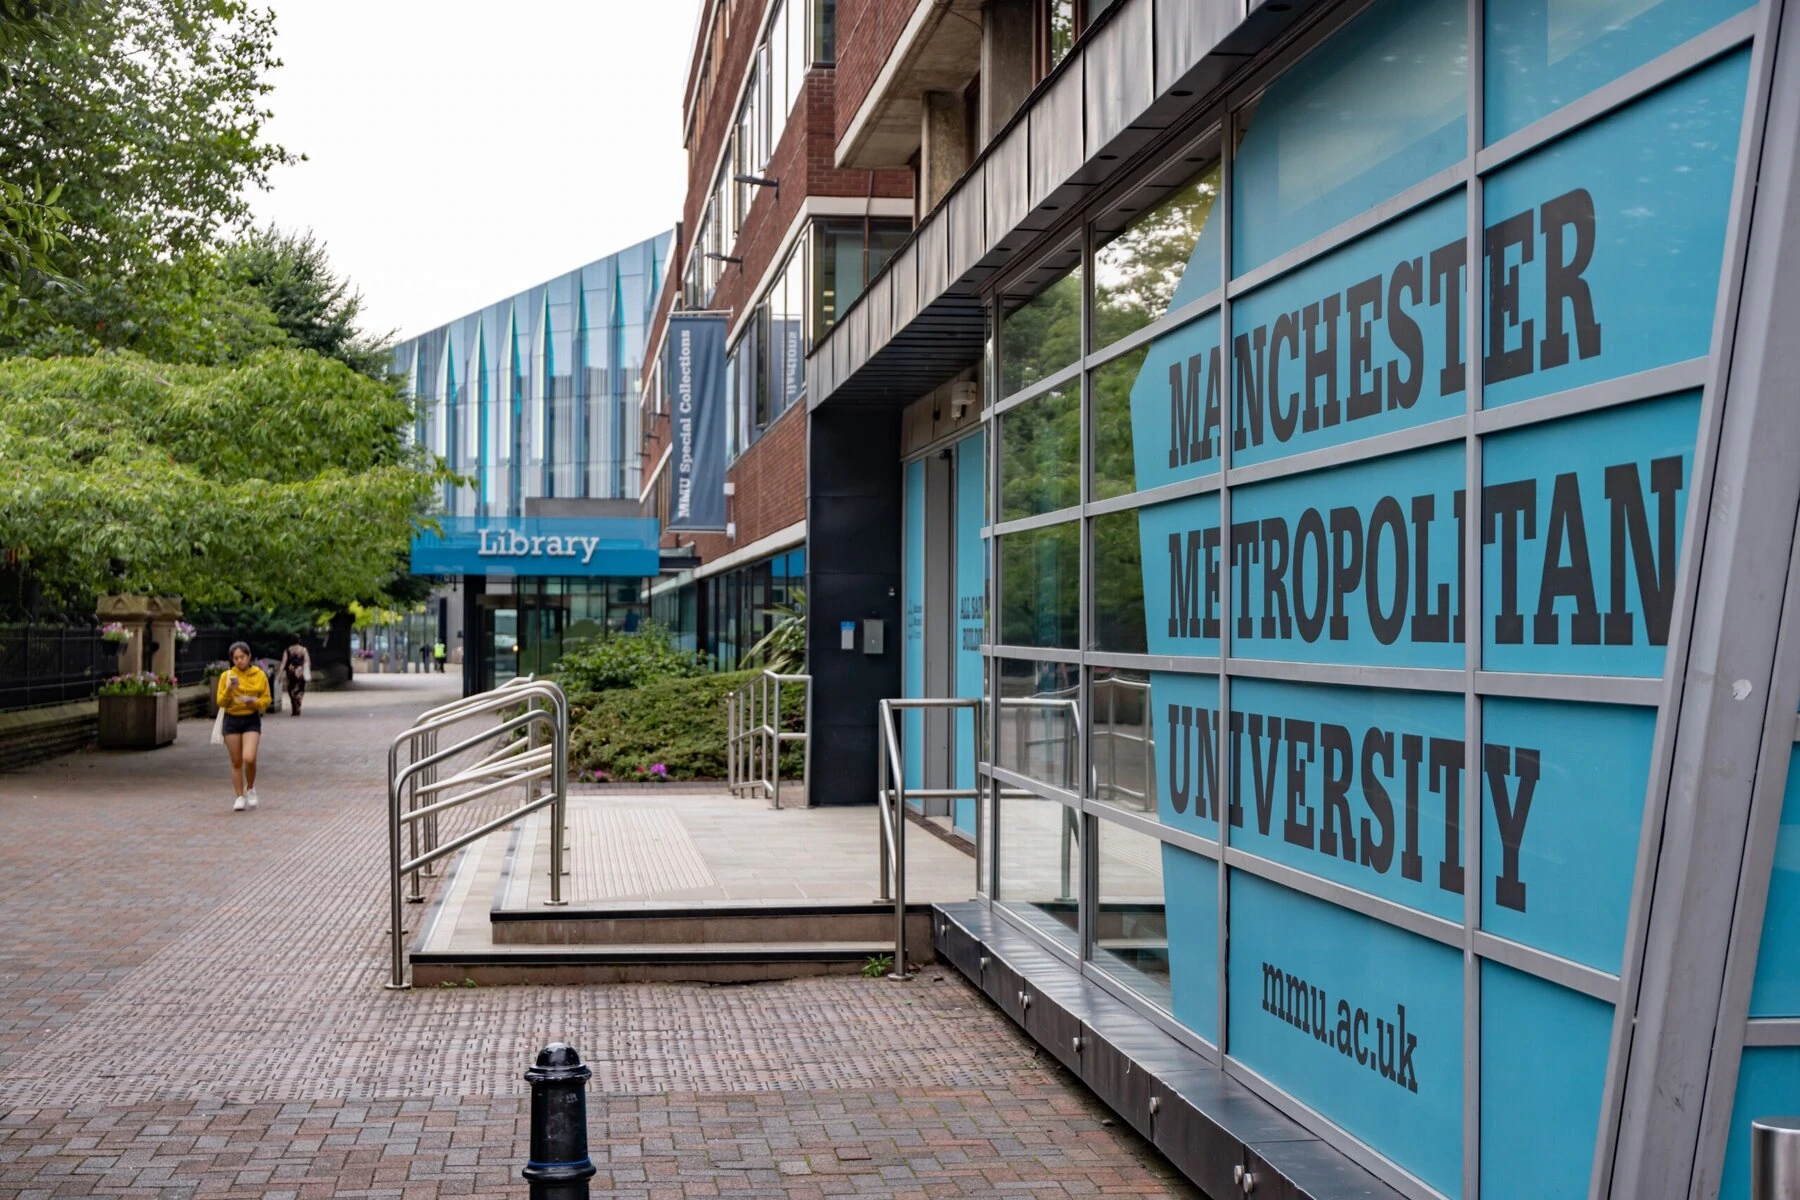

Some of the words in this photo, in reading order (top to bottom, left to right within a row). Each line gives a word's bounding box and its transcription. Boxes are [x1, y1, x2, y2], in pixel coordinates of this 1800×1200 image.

[679, 330, 691, 413] Collections
[1168, 187, 1602, 469] MANCHESTER
[679, 478, 691, 517] MMU
[680, 419, 693, 472] Special
[478, 529, 599, 563] Library
[1168, 454, 1683, 646] METROPOLITAN
[1168, 704, 1541, 913] UNIVERSITY
[1262, 961, 1419, 1094] mmu.ac.uk
